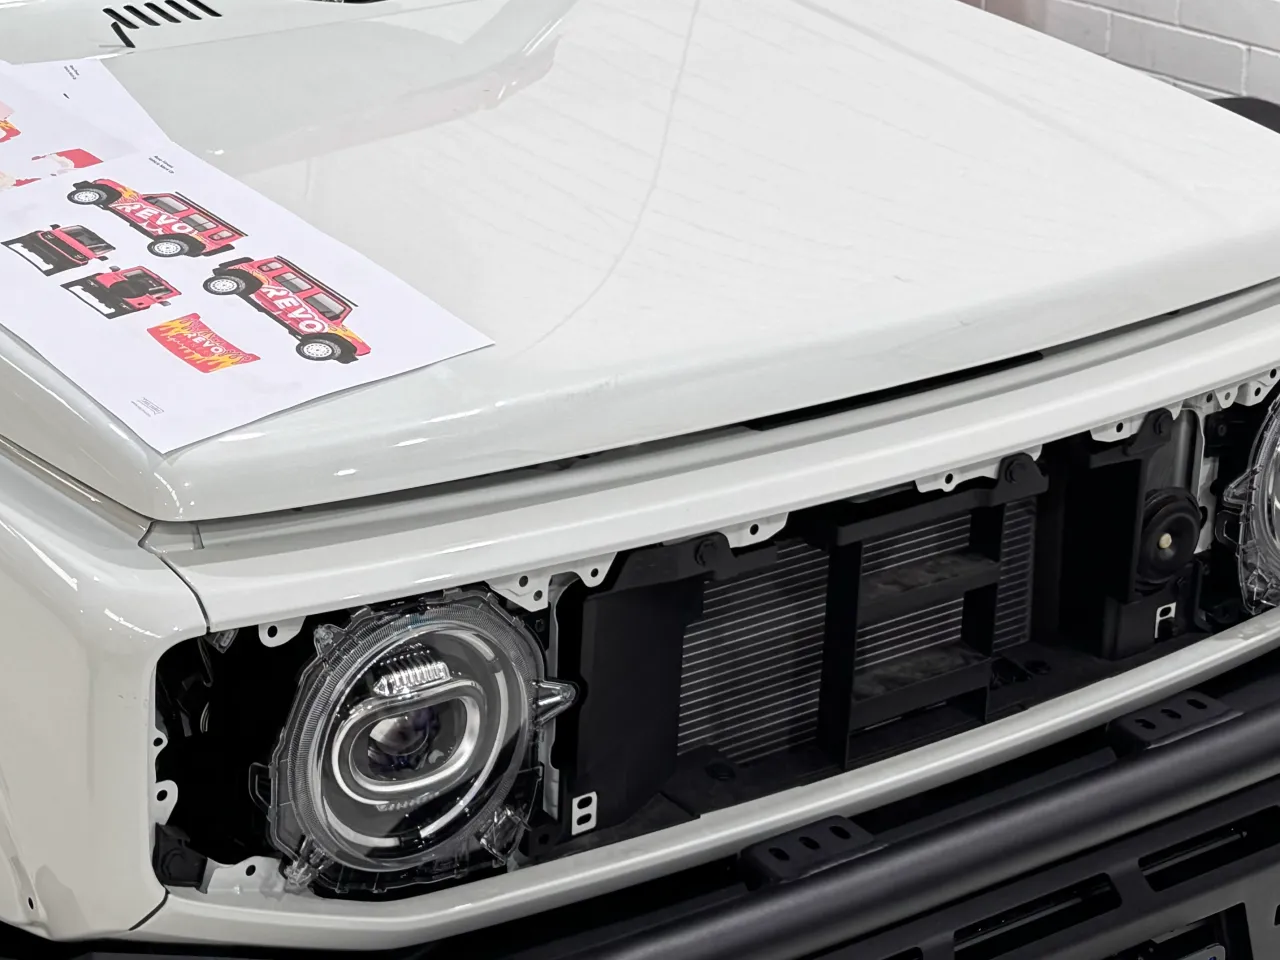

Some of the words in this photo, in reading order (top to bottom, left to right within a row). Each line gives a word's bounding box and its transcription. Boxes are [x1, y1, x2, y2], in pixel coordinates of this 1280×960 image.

[116, 203, 193, 233] REVO
[263, 287, 325, 333] REVO
[184, 333, 224, 354] REVO
